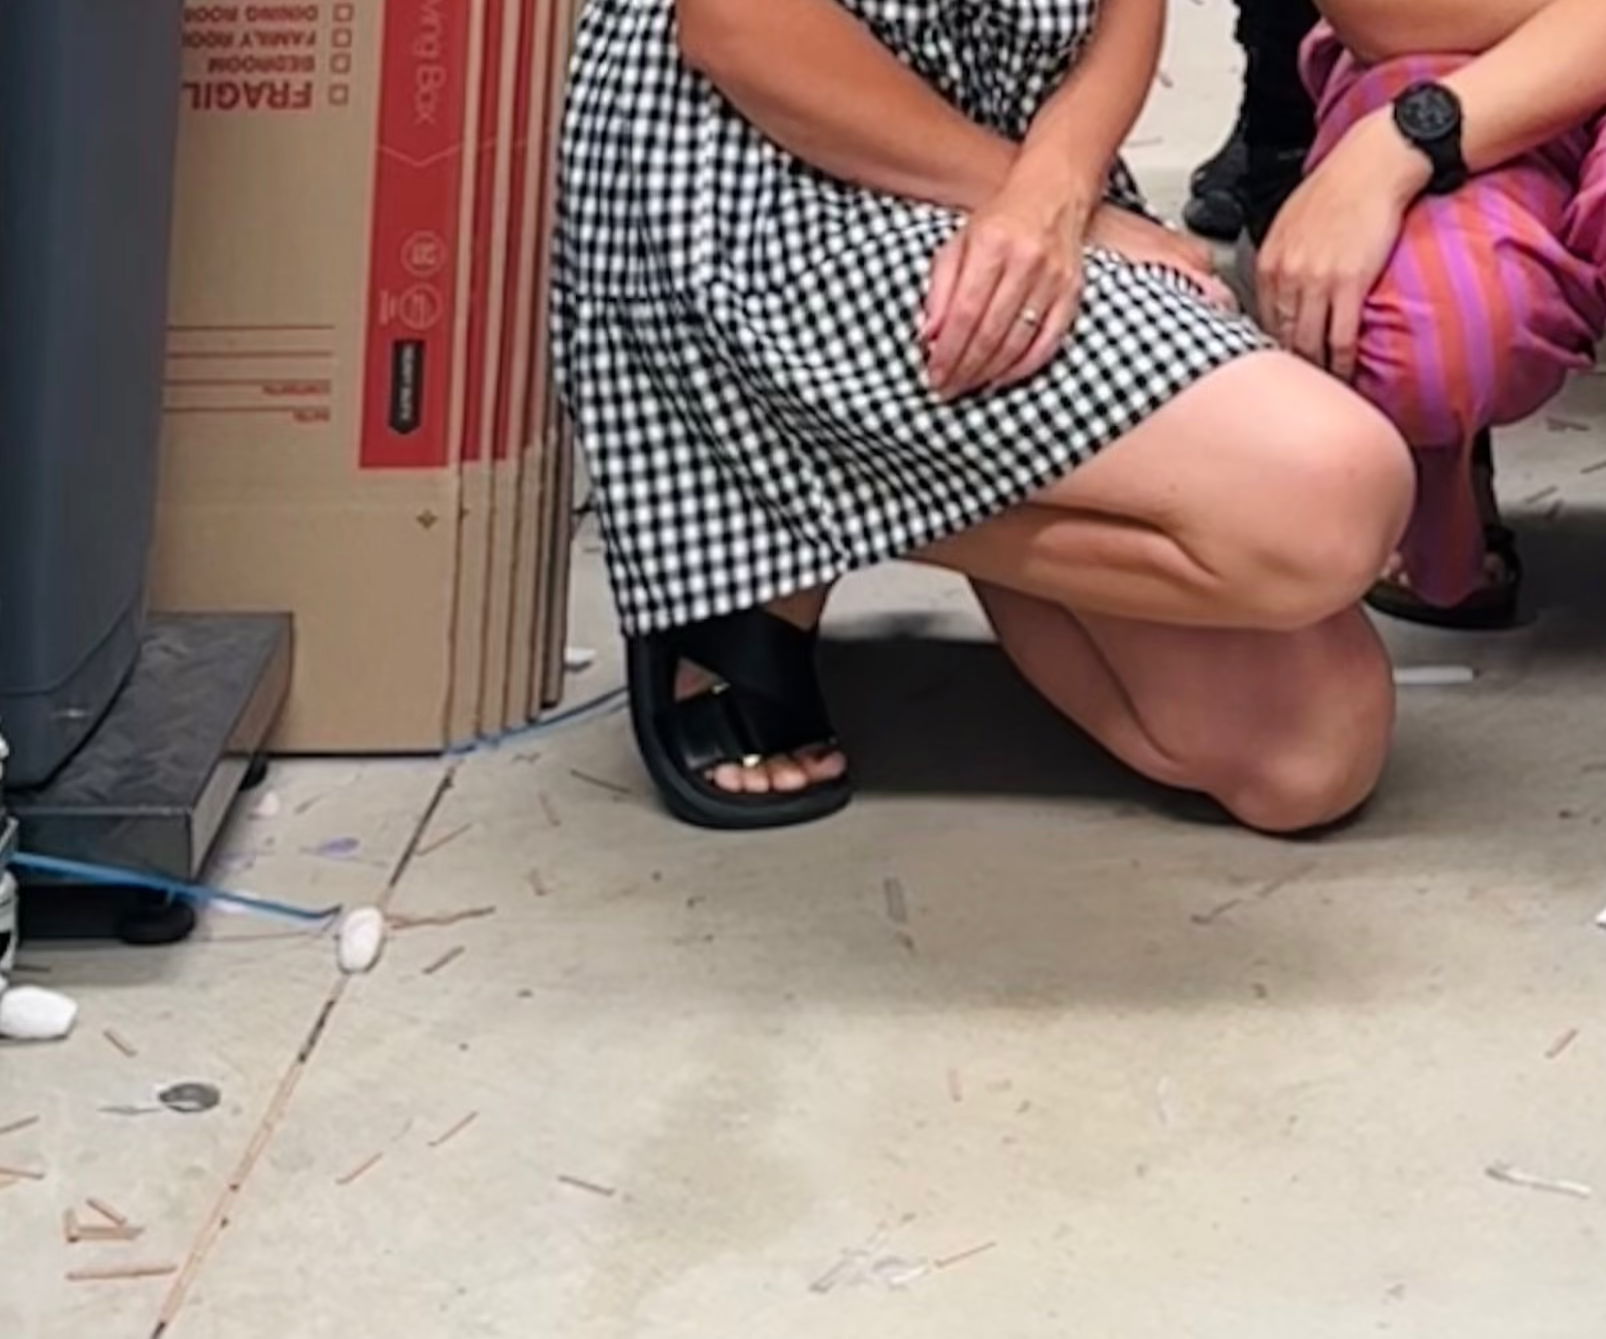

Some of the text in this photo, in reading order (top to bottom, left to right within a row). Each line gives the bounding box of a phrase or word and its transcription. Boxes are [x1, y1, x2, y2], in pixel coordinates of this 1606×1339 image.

[245, 6, 319, 22] DINING
[239, 31, 317, 48] FAMILY
[207, 55, 316, 73] BEDROOM
[181, 81, 314, 110] FRAGIL
[414, 64, 446, 126] Box
